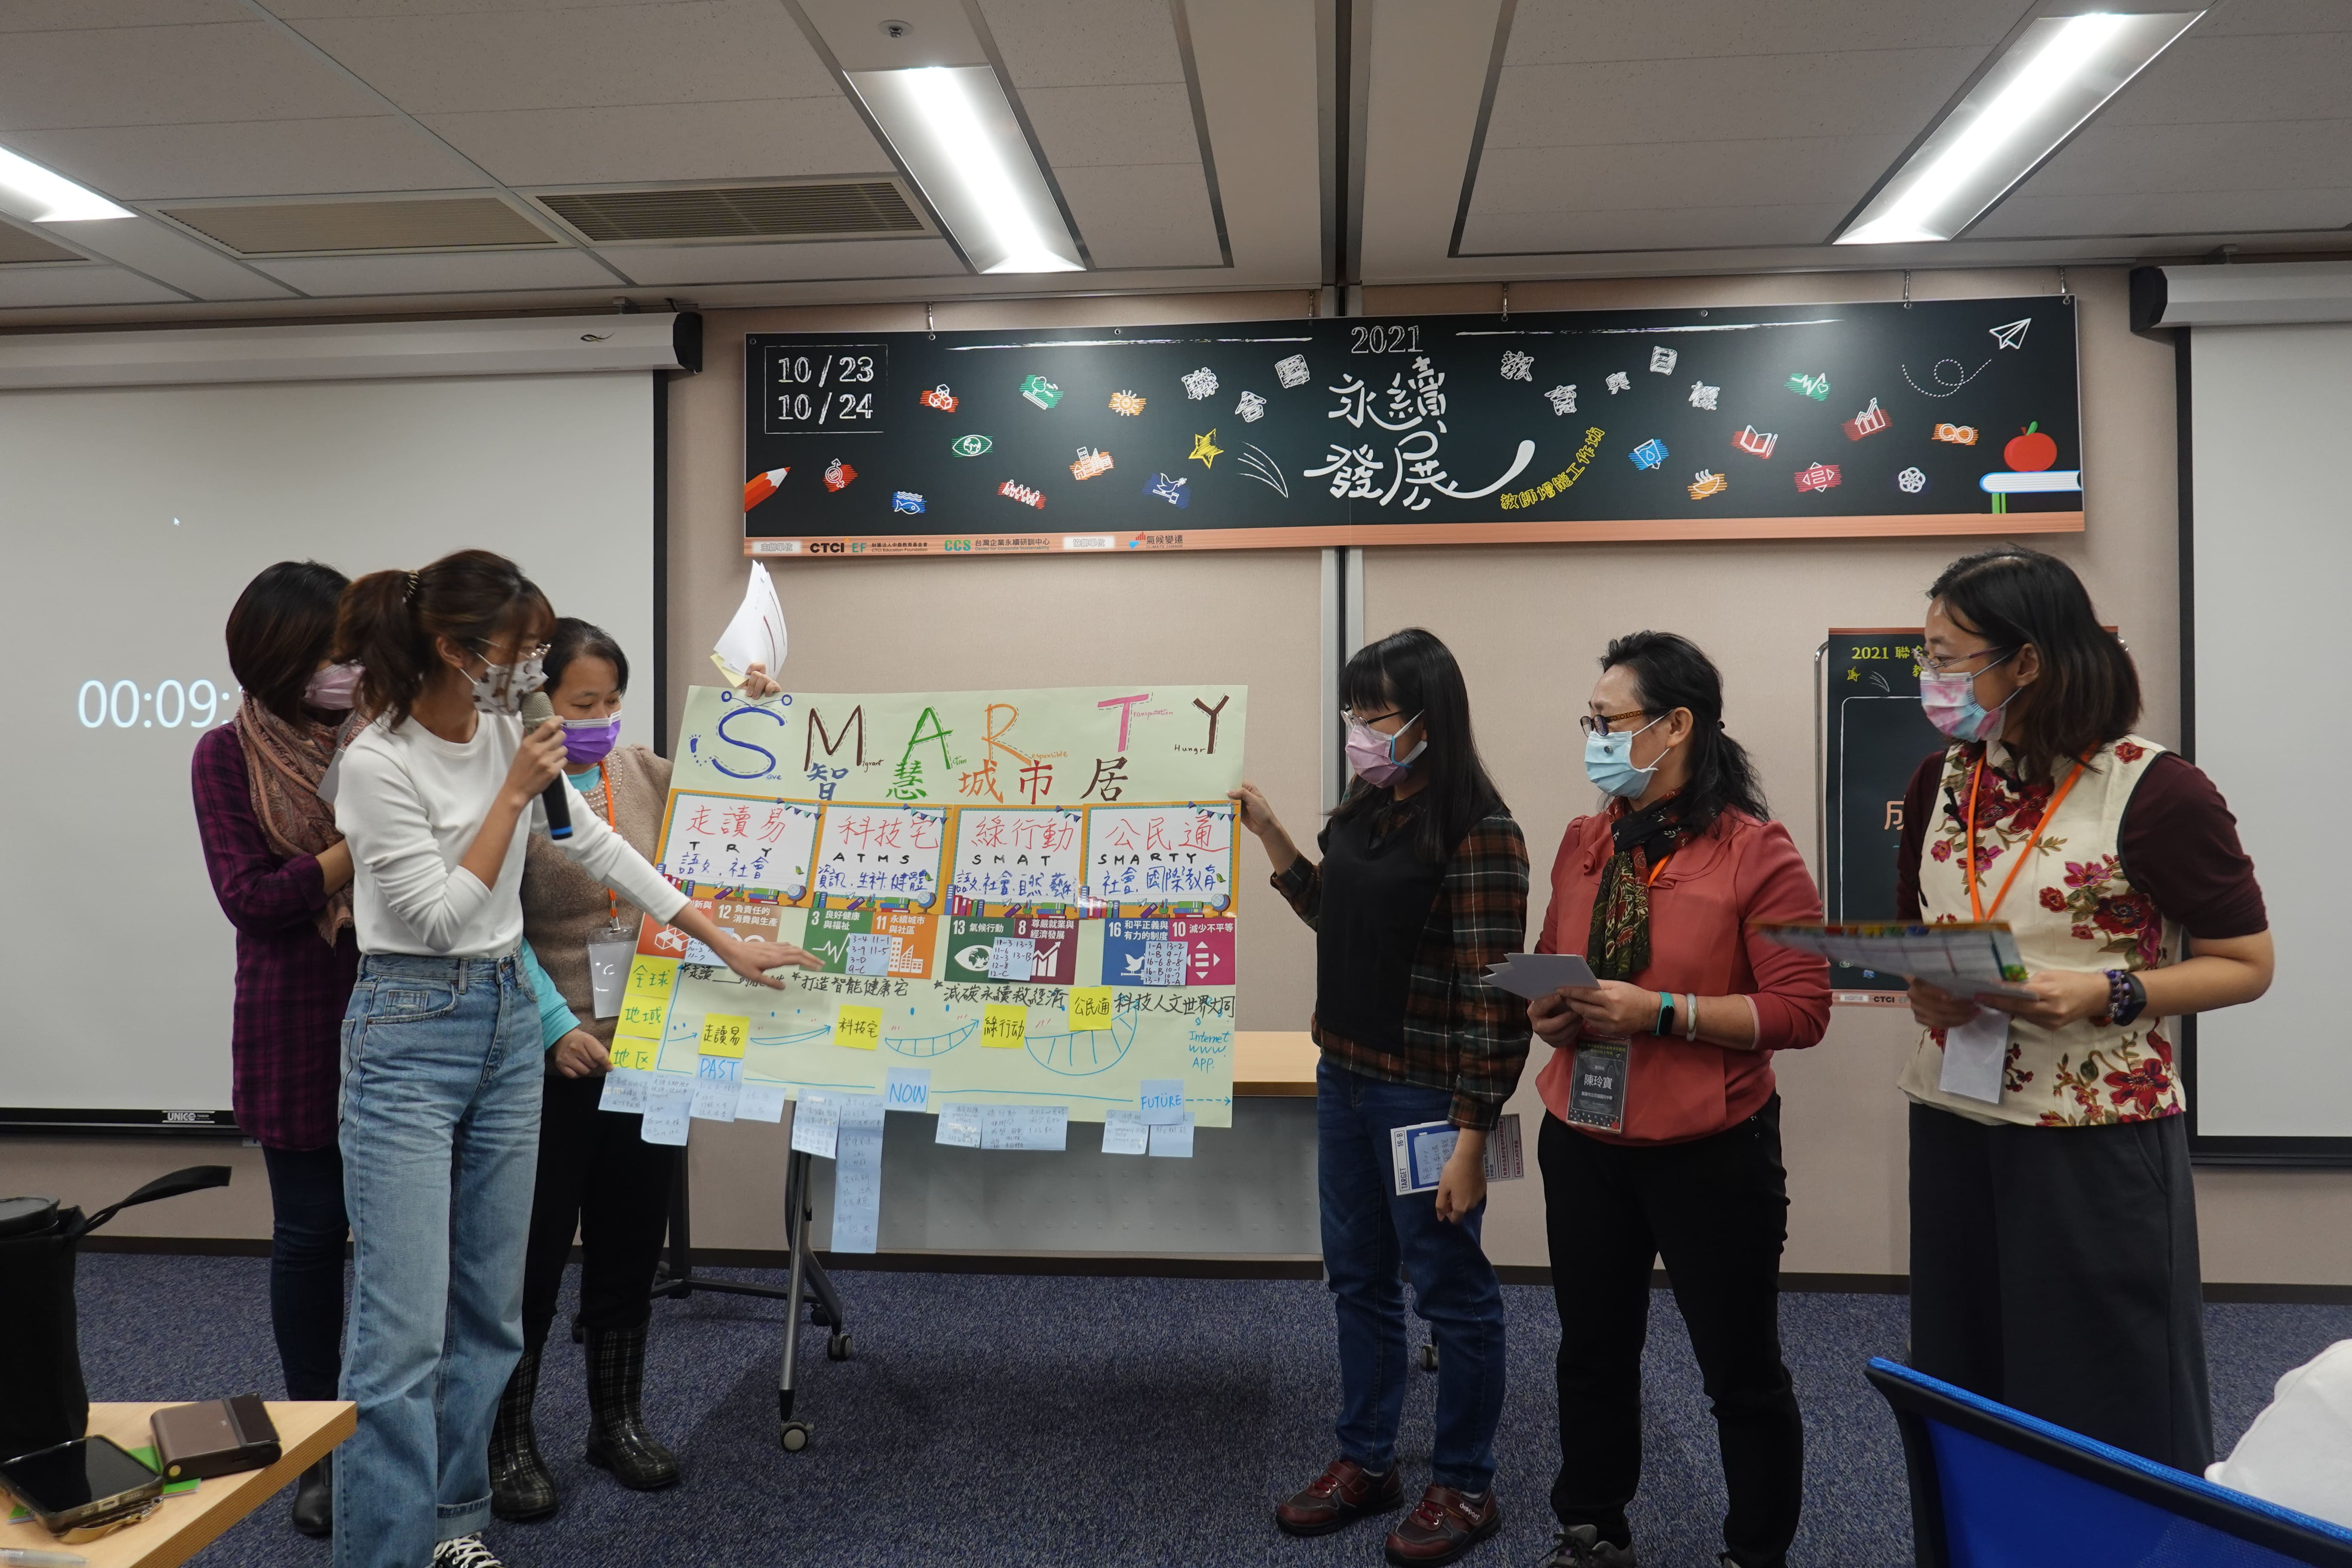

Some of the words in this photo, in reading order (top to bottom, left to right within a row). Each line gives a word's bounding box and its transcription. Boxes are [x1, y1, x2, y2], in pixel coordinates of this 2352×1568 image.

[1351, 325, 1423, 354] 2021
[1501, 426, 1605, 510] 教師增能工作坊
[944, 539, 971, 551] CCS
[1146, 534, 1183, 545] 氣候變遷
[810, 542, 845, 553] CTCI
[852, 543, 867, 553] EF
[1851, 646, 1890, 659] 2021
[686, 805, 786, 843] 走讀易
[838, 815, 939, 850] 科技宅
[1105, 815, 1231, 852] 公民通
[718, 904, 732, 919] 12
[734, 904, 771, 916] 負責任的
[825, 910, 861, 921] 良好健康
[733, 914, 778, 927] 消費與生產
[812, 911, 821, 925] 3
[823, 920, 850, 930] 與福祉
[876, 916, 887, 930] 11
[890, 914, 925, 925] 永續城市
[1031, 919, 1075, 930] 尊嚴就業與
[1124, 919, 1169, 930] 和平正義與
[889, 925, 916, 935] 與社區
[952, 920, 966, 935] 13
[969, 922, 1004, 933] 氣候行動
[1018, 920, 1027, 935] 8
[1030, 929, 1065, 940] 經濟發展
[1108, 922, 1121, 937] 16
[1172, 922, 1186, 937] 10
[1189, 922, 1234, 934] 減少不平等
[1124, 931, 1168, 941] 有力的制度
[633, 965, 670, 988] 全球
[1074, 996, 1109, 1016] 公民通
[1114, 991, 1235, 1019] 科技人文世界大同
[625, 1006, 662, 1025] 地域
[703, 1023, 740, 1046] 走讀易
[839, 1017, 878, 1038] 科技宅
[1188, 1031, 1231, 1044] Internet
[700, 1057, 741, 1081] PAST
[889, 1083, 926, 1103] NOW
